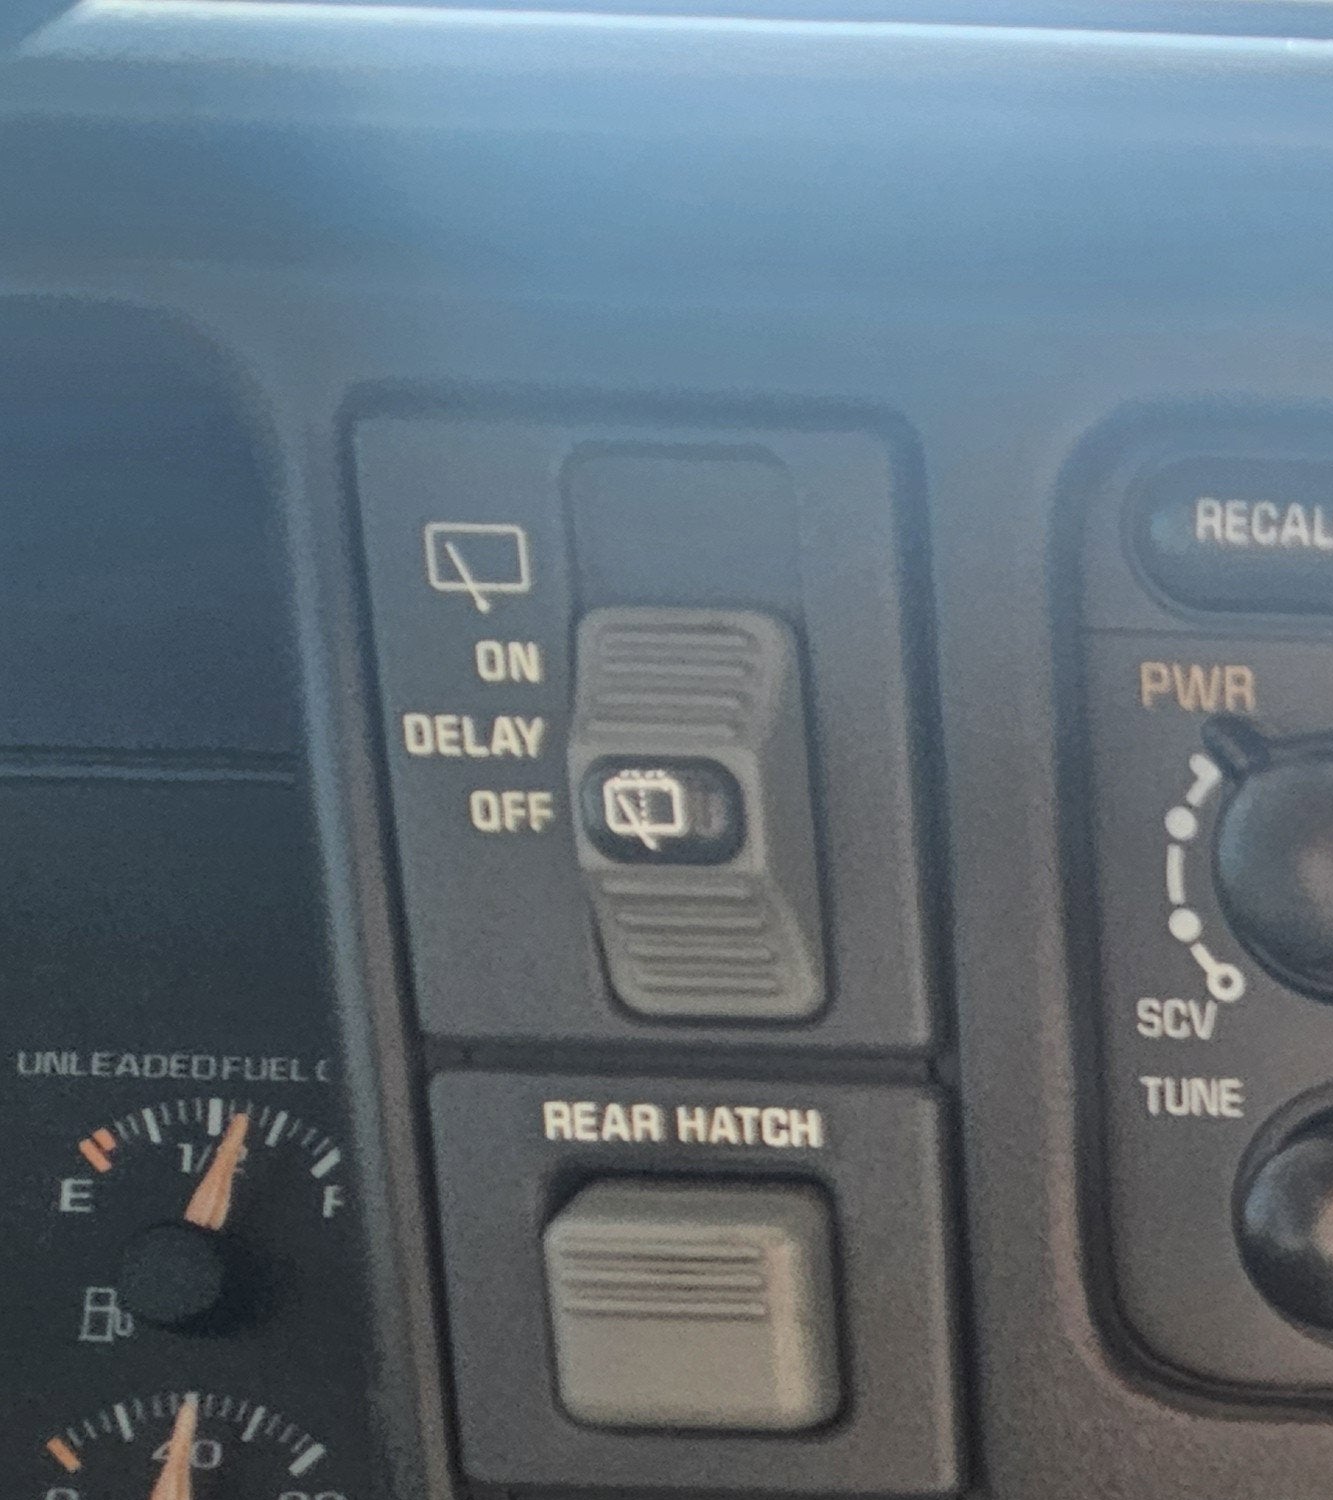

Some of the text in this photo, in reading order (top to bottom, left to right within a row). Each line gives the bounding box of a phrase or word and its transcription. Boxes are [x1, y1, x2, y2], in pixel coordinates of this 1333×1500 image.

[475, 641, 541, 682] ON
[1139, 661, 1256, 711] PWR
[402, 713, 545, 760] DELAY
[469, 790, 554, 832] OFF
[1136, 996, 1218, 1040] SCV
[15, 1050, 218, 1082] UNLEADED
[221, 1055, 310, 1083] FUEL
[1139, 1075, 1244, 1119] TUNE
[543, 1100, 823, 1149] REAR HATCH
[58, 1178, 95, 1214] E
[321, 1184, 345, 1219] F
